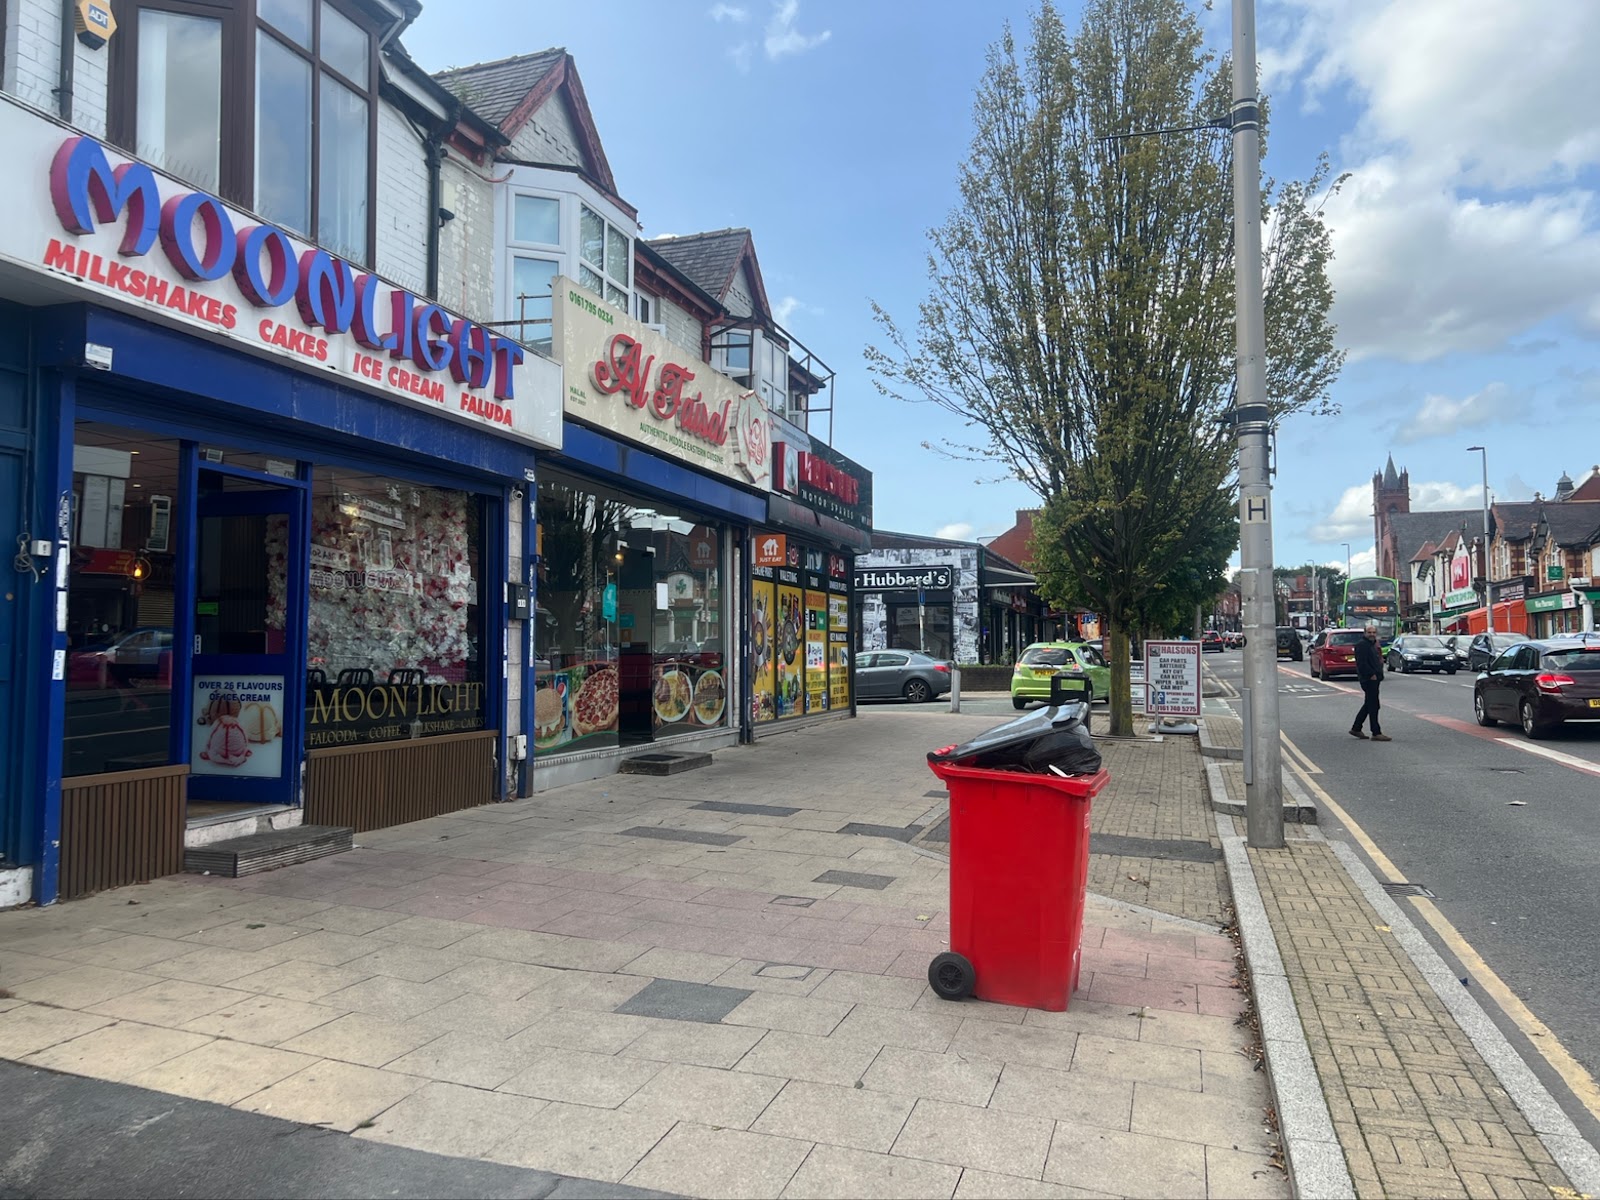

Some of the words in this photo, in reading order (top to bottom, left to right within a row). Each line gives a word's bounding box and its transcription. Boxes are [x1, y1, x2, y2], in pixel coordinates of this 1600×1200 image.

[50, 135, 523, 400] MOONLIGHT
[569, 291, 584, 309] 0161
[585, 299, 597, 316] 795
[597, 307, 614, 325] 0234
[43, 238, 236, 329] MILKSHAKES
[259, 318, 328, 362] CAKES
[353, 353, 382, 382] ICE
[388, 364, 444, 404] CREAM
[460, 391, 513, 428] FALUDA
[590, 333, 655, 409] Al
[650, 362, 732, 447] Faisal
[640, 422, 668, 443] AUTHENTIC
[668, 434, 686, 451] MIDDLE
[686, 441, 706, 459] EASTERN
[706, 450, 724, 465] CUISINE
[802, 489, 827, 508] MOTOR
[831, 502, 854, 520] SPARES
[1248, 498, 1266, 521] H
[863, 571, 948, 587] Hubbard's
[1161, 646, 1197, 655] HALSONS
[198, 681, 222, 689] OVER
[224, 681, 235, 690] 26
[236, 682, 283, 691] FLAVOURS
[223, 693, 237, 701] ICE
[240, 694, 271, 702] CREAM
[310, 685, 409, 724] MOON
[416, 682, 484, 716] LIGHT
[310, 729, 358, 746] FALOODA
[368, 726, 401, 739] COFFEE
[460, 718, 484, 728] CAKES
